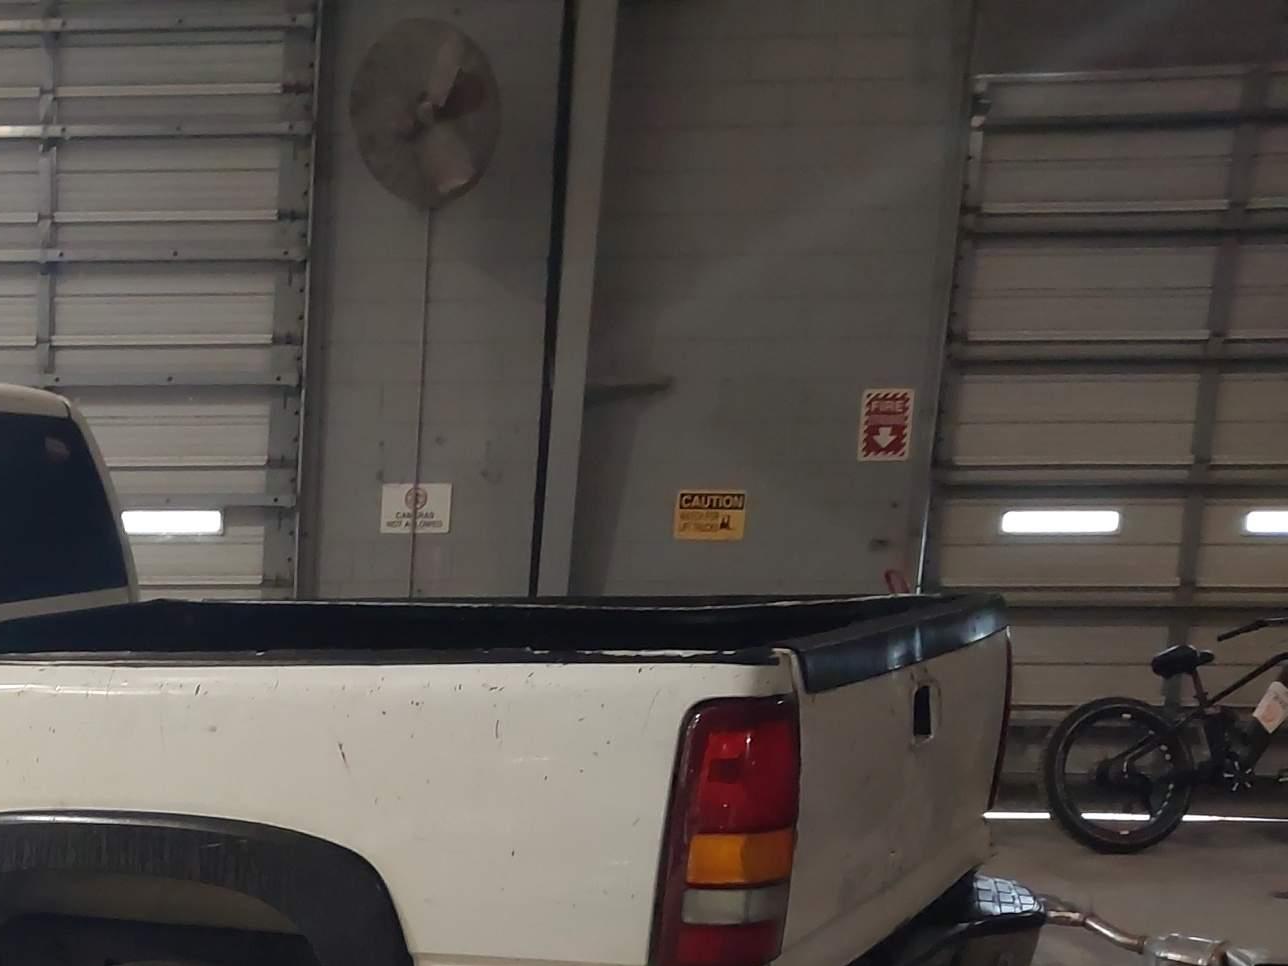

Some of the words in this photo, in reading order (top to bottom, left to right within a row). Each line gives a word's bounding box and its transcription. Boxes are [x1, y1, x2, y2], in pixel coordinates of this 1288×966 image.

[871, 400, 904, 413] FIRE
[682, 495, 743, 508] CAUTION
[395, 511, 435, 519] CAMRAS
